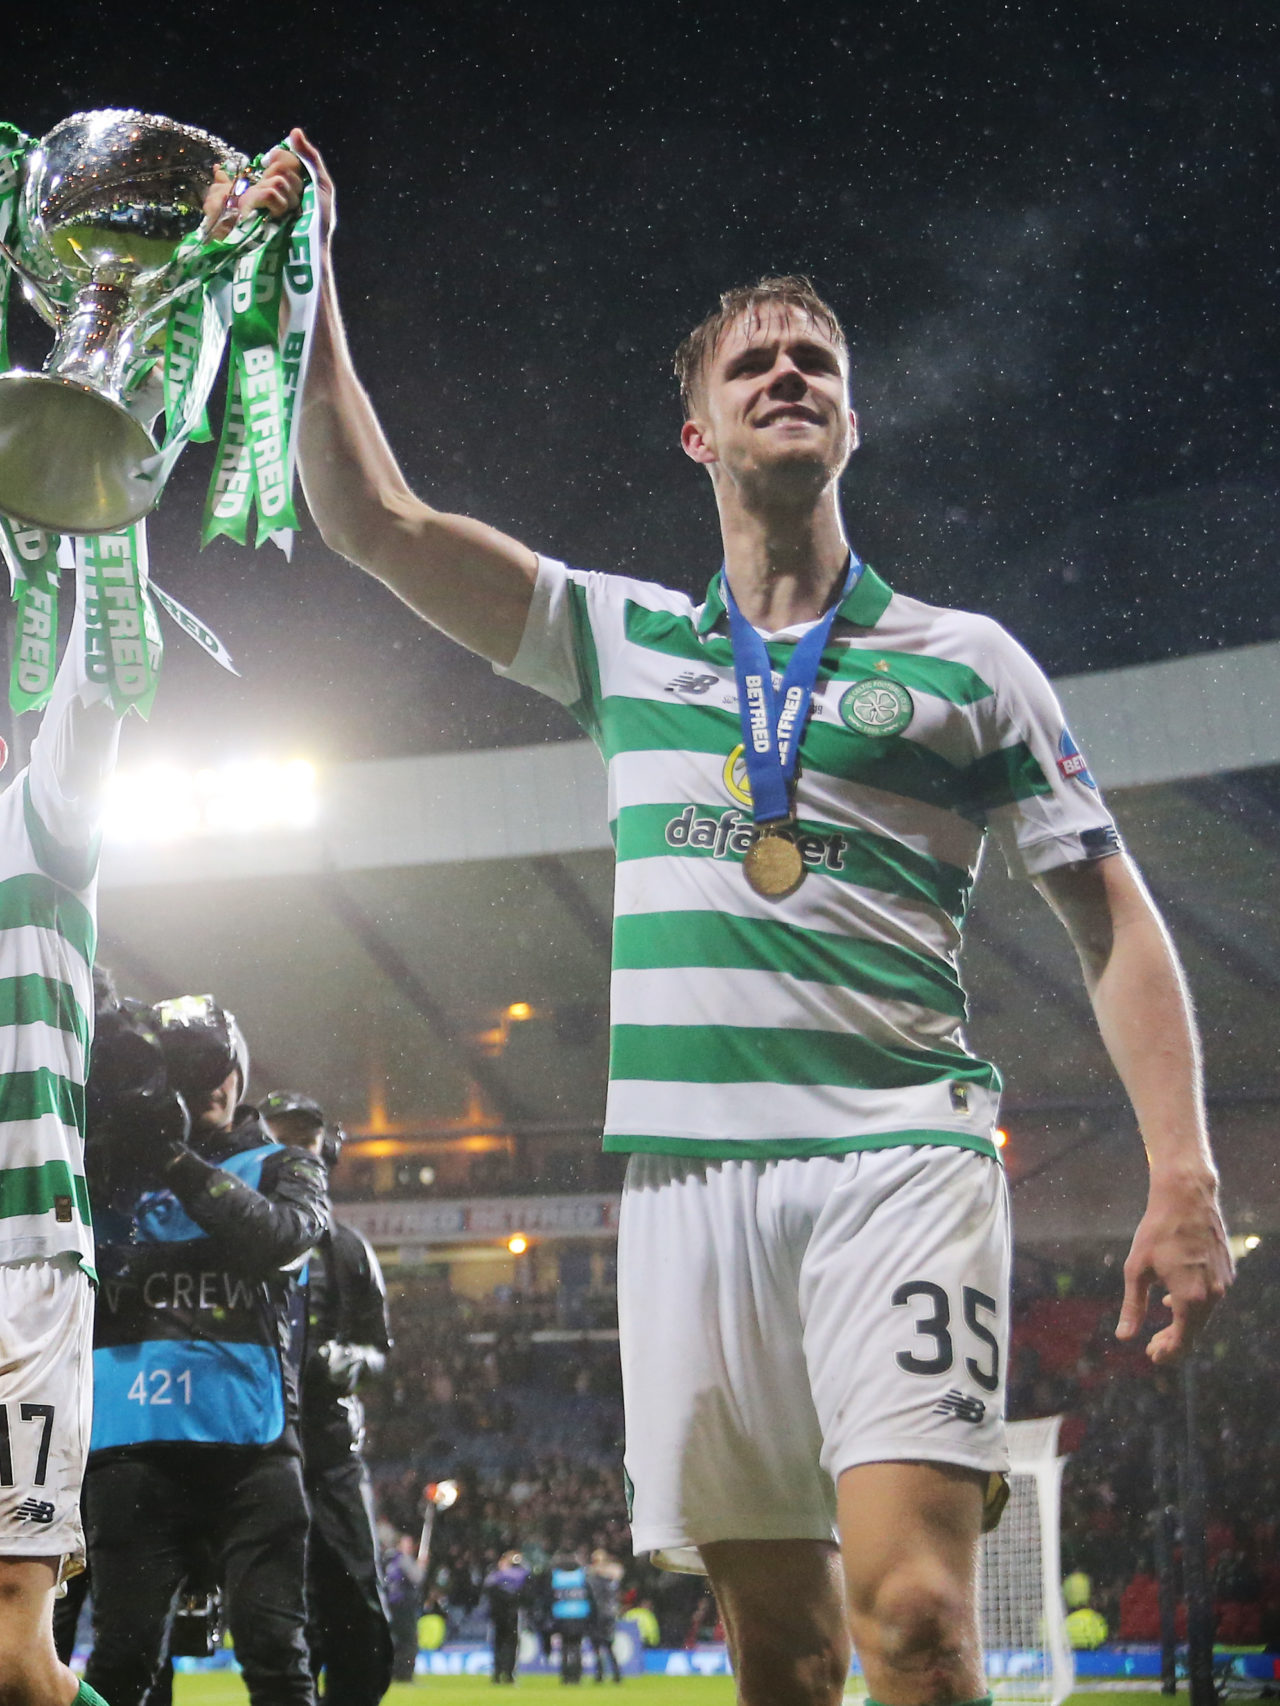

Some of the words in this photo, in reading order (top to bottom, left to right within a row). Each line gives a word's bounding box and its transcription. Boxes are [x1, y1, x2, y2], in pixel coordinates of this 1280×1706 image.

[243, 344, 286, 517] BETFRED
[18, 586, 53, 694] FRED
[99, 533, 148, 695] ETFRED
[745, 675, 770, 754] BETFRED
[665, 805, 848, 871] dafaet
[143, 1272, 254, 1309] CREW
[891, 1279, 999, 1392] 35
[127, 1369, 192, 1405] 421
